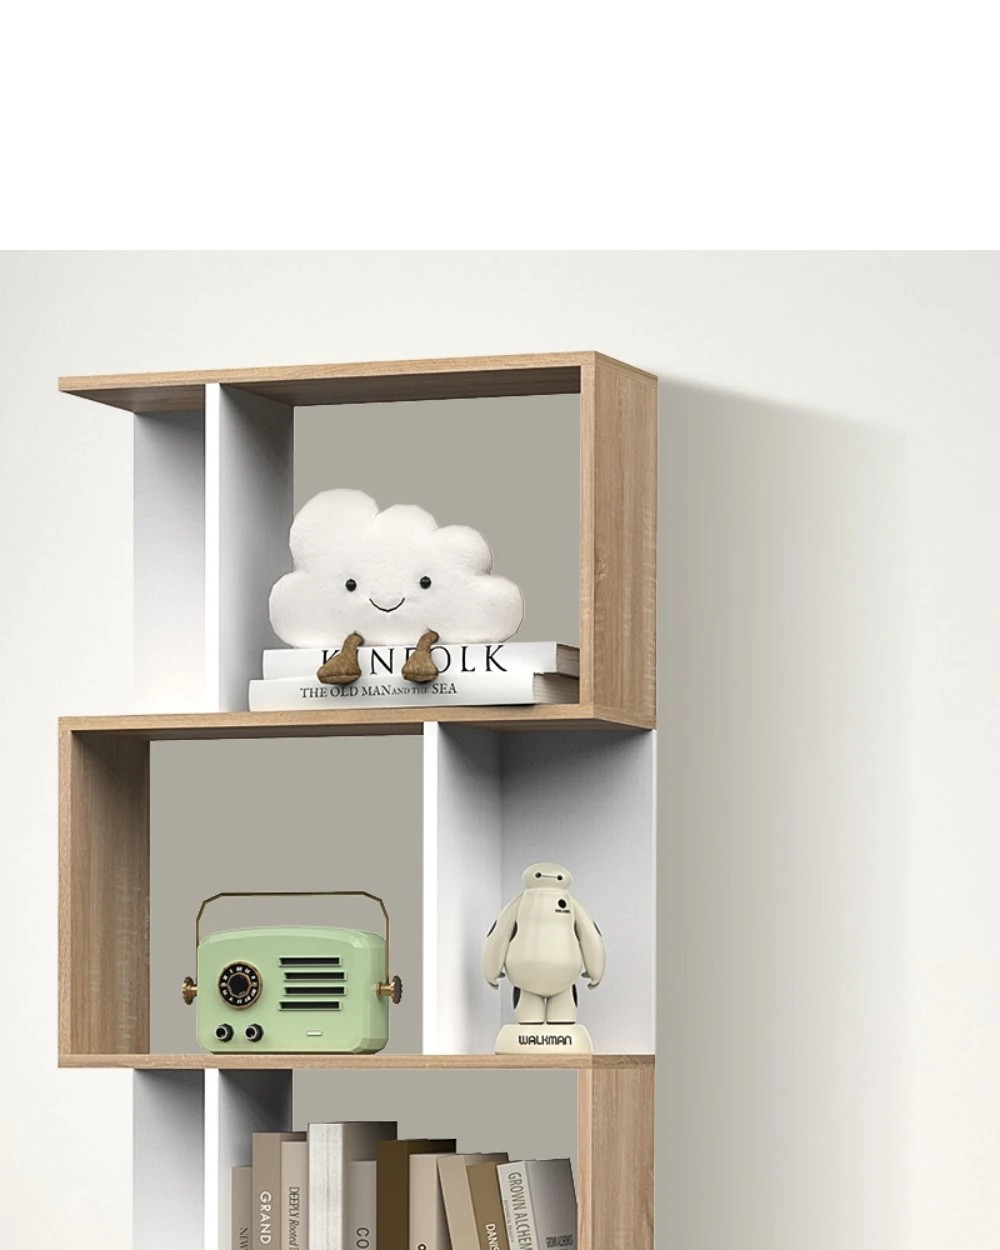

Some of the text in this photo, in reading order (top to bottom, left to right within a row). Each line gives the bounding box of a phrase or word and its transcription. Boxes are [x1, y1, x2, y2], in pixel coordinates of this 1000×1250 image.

[322, 644, 508, 675] KNOLK
[300, 687, 327, 698] THE
[330, 685, 359, 698] OLD
[362, 684, 391, 696] MAN
[391, 687, 410, 695] AND
[431, 682, 457, 695] SEA
[518, 1035, 572, 1046] WALKMAN
[288, 1186, 300, 1218] DEEPLY
[508, 1171, 527, 1211] GROWN
[259, 1190, 272, 1245] GRAND
[239, 1227, 249, 1250] NEW
[288, 1219, 300, 1247] Rooted
